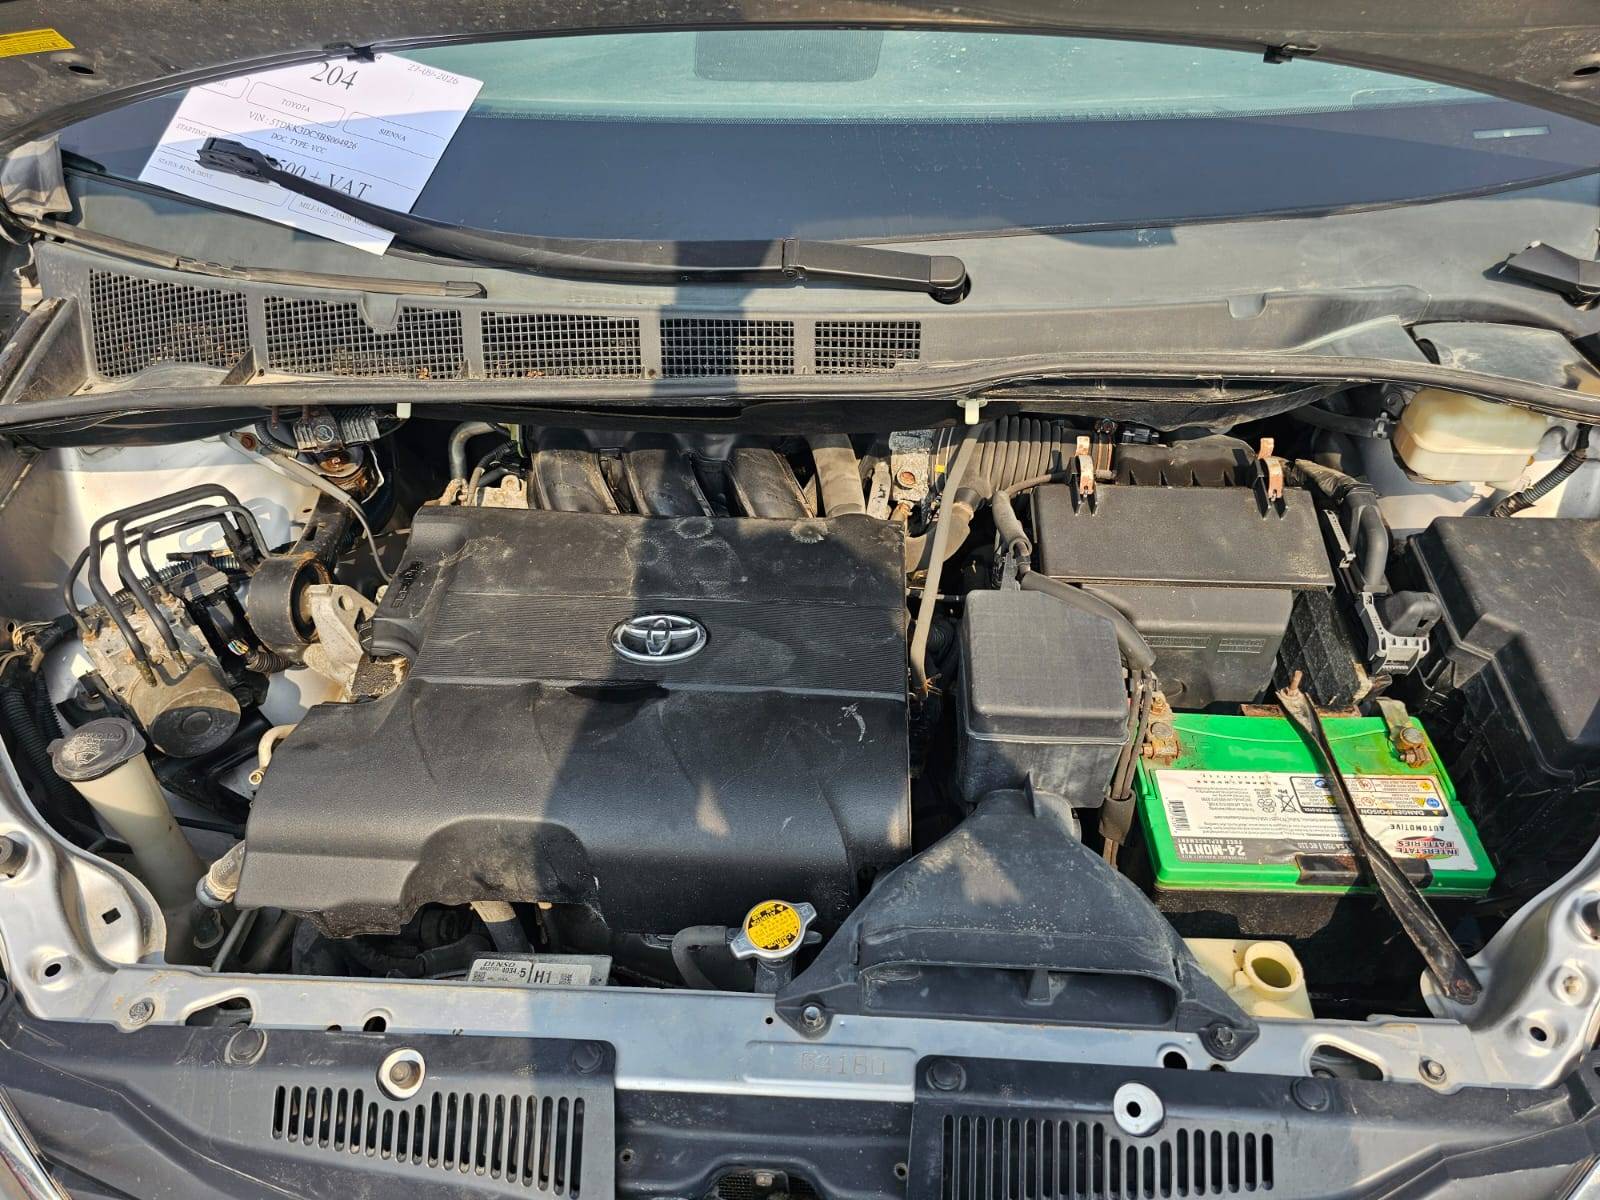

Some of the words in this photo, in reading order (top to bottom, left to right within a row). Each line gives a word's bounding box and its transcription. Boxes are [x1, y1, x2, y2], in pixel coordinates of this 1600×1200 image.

[310, 62, 358, 90] 204
[281, 98, 311, 113] TOYOTA
[378, 128, 406, 142] SIENNA
[329, 173, 372, 198] VAT
[1389, 823, 1445, 832] AUTOMOTIVE
[1178, 843, 1246, 856] 24-MONTH
[1398, 840, 1456, 848] BATTERIES
[1395, 847, 1458, 856] INTERSTATE
[483, 960, 516, 968] DENSO
